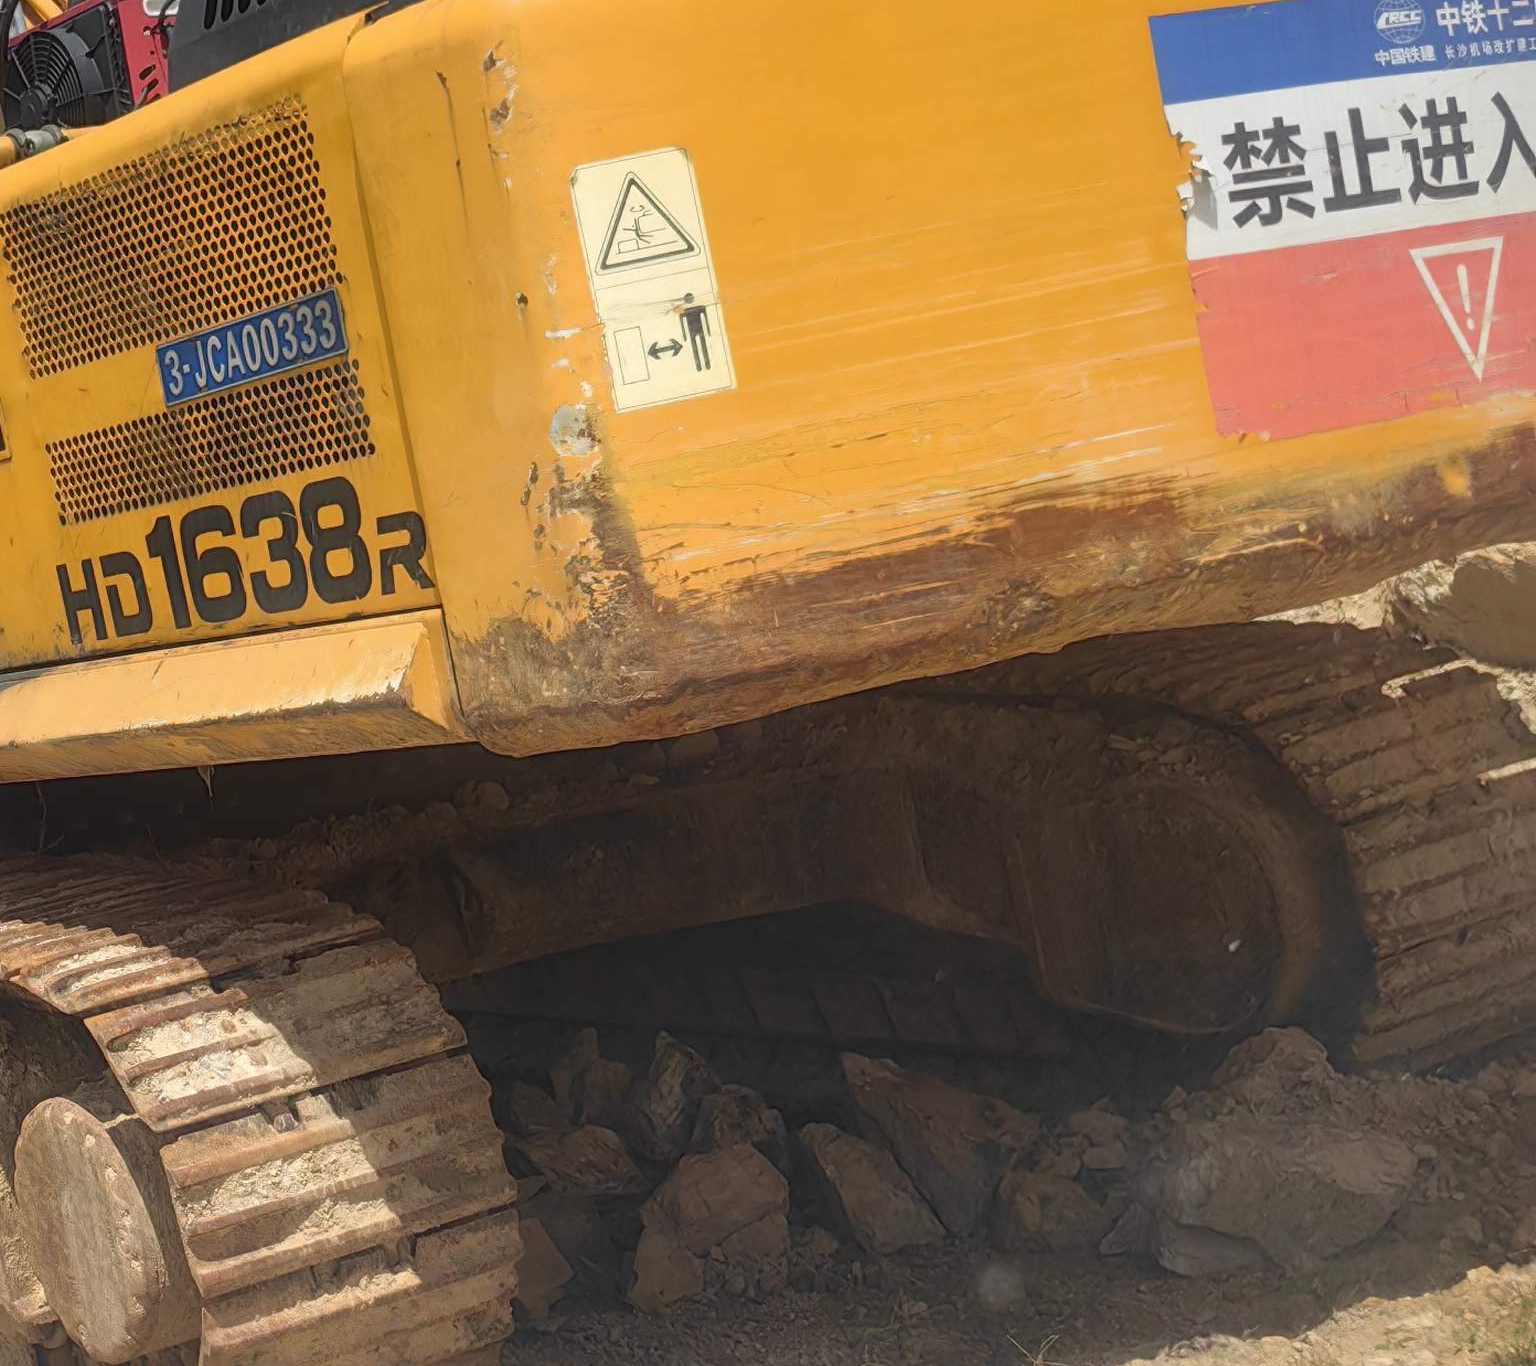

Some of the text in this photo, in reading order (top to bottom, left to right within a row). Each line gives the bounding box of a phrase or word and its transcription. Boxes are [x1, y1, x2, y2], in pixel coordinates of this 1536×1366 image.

[1374, 44, 1437, 67] 中国铁建
[1220, 91, 1536, 229] 禁止进入
[164, 298, 338, 396] 3-JCA00333
[55, 475, 436, 645] HD1638R
